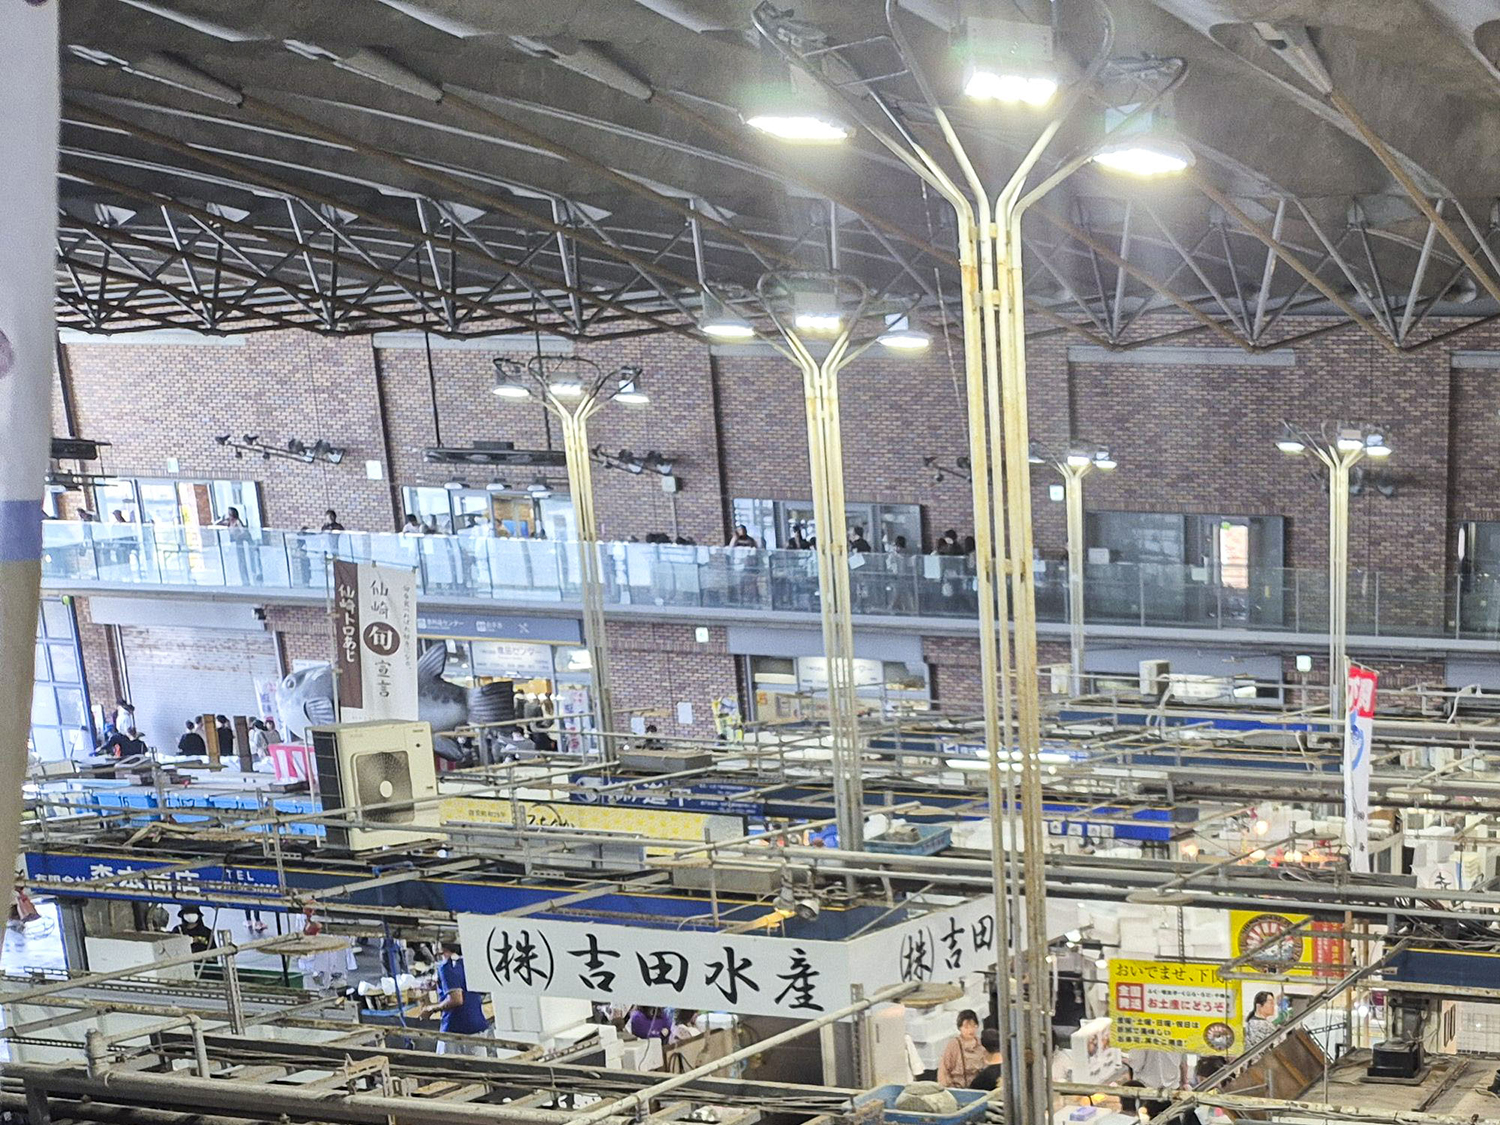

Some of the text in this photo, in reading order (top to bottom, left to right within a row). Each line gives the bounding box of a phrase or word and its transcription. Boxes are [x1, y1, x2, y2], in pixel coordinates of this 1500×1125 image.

[368, 625, 393, 651] 旬
[226, 869, 255, 881] TEL
[486, 926, 825, 1013] (株)吉田水産
